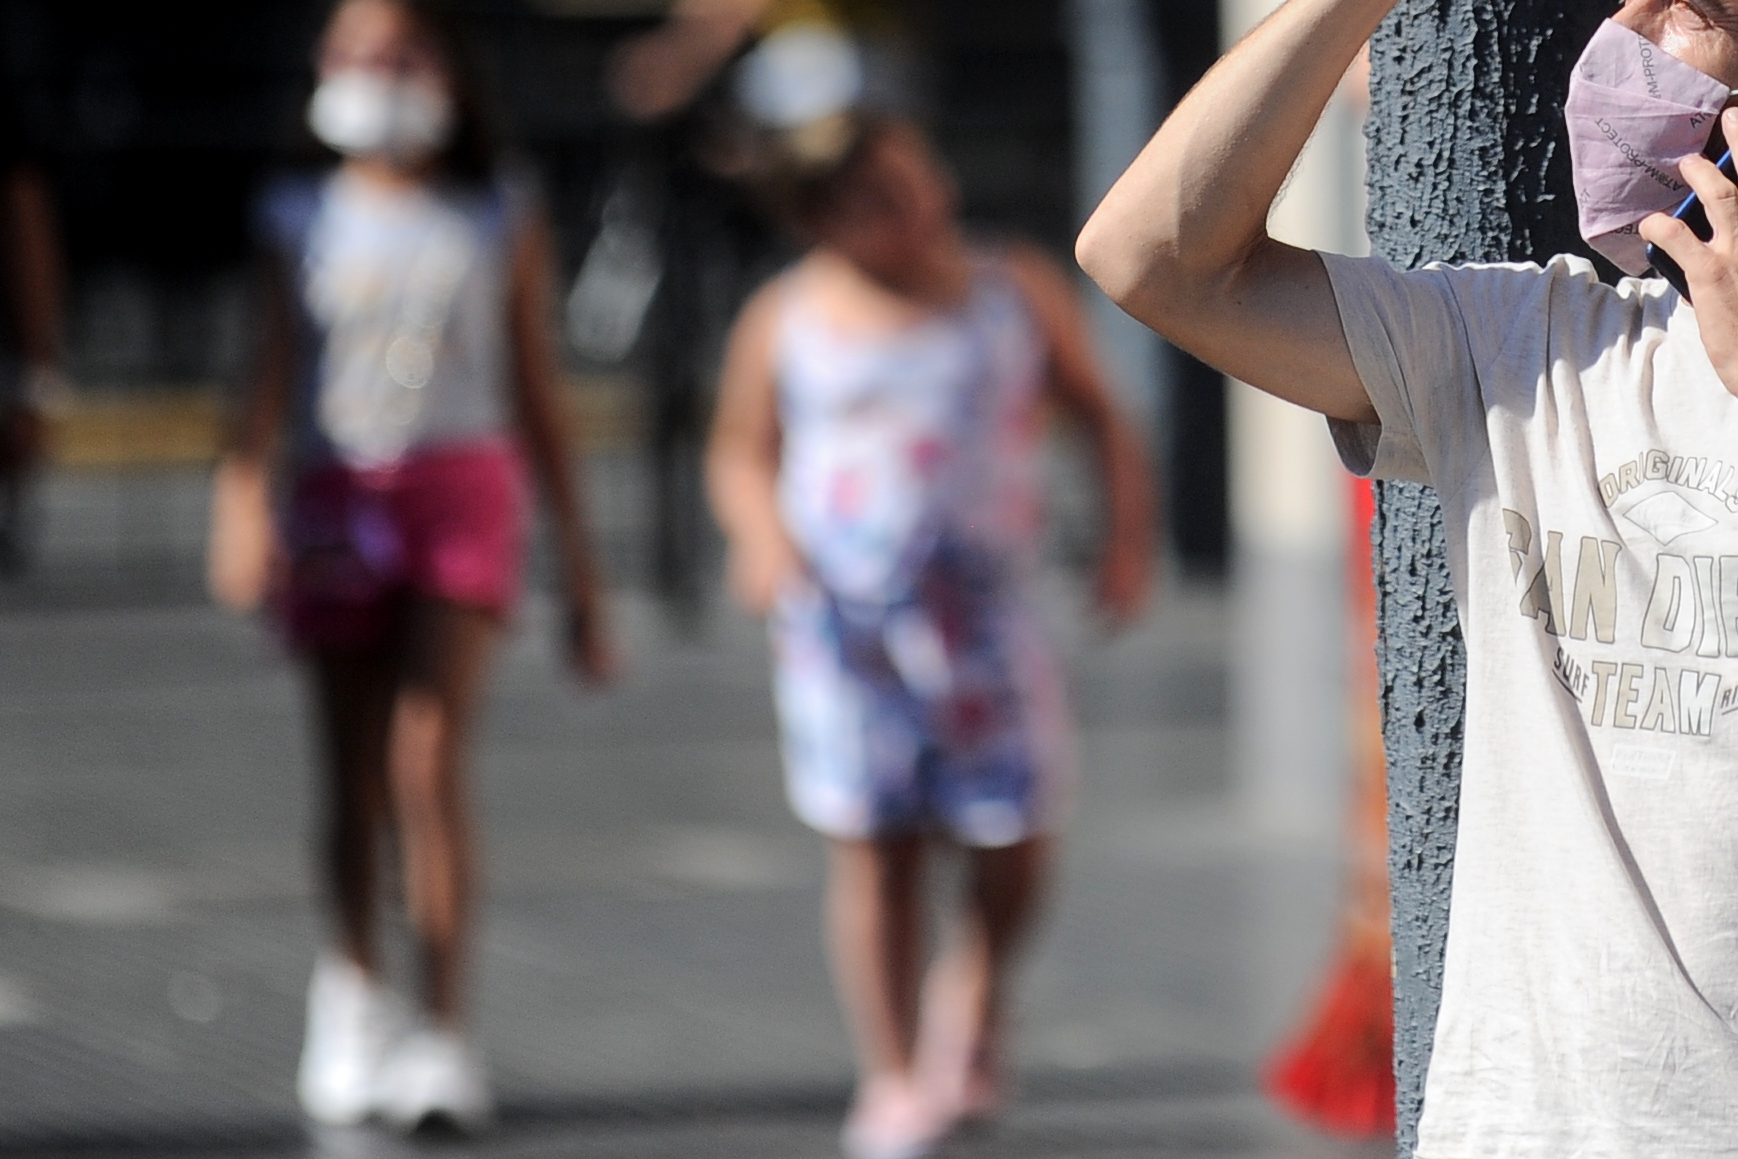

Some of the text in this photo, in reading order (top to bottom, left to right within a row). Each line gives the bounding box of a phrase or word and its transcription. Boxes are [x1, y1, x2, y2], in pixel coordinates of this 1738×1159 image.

[1690, 111, 1713, 129] AT
[1553, 647, 1590, 697] SURF
[1591, 661, 1721, 736] TEAM
